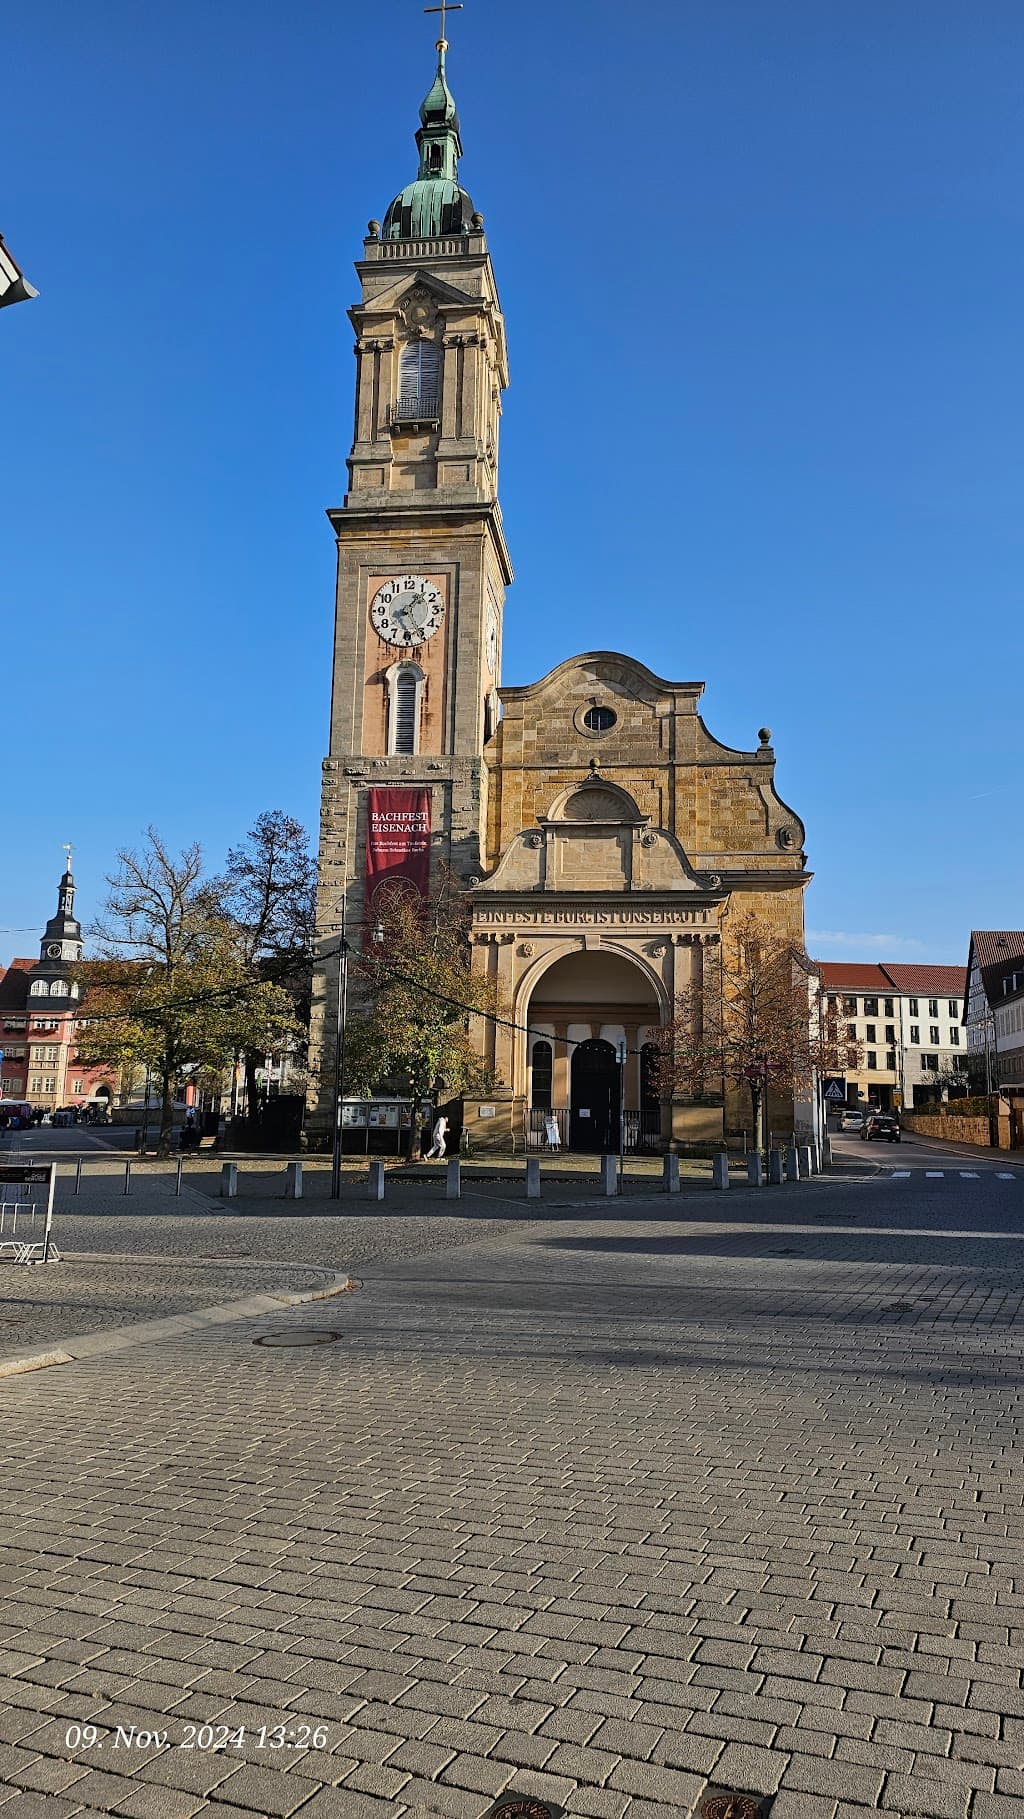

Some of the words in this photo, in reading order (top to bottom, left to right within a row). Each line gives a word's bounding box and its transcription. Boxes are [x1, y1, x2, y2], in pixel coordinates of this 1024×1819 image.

[392, 584, 400, 593] 11
[404, 580, 415, 590] 12
[421, 584, 424, 592] 1
[381, 594, 392, 603] 10
[428, 592, 437, 602] 2
[378, 606, 386, 616] 9
[432, 605, 440, 615] 3
[381, 619, 389, 628] 8
[427, 618, 435, 627] 4
[391, 629, 398, 638] 7
[403, 631, 411, 640] 6
[371, 812, 429, 821] BACHFEST
[371, 823, 427, 833] EISENACH
